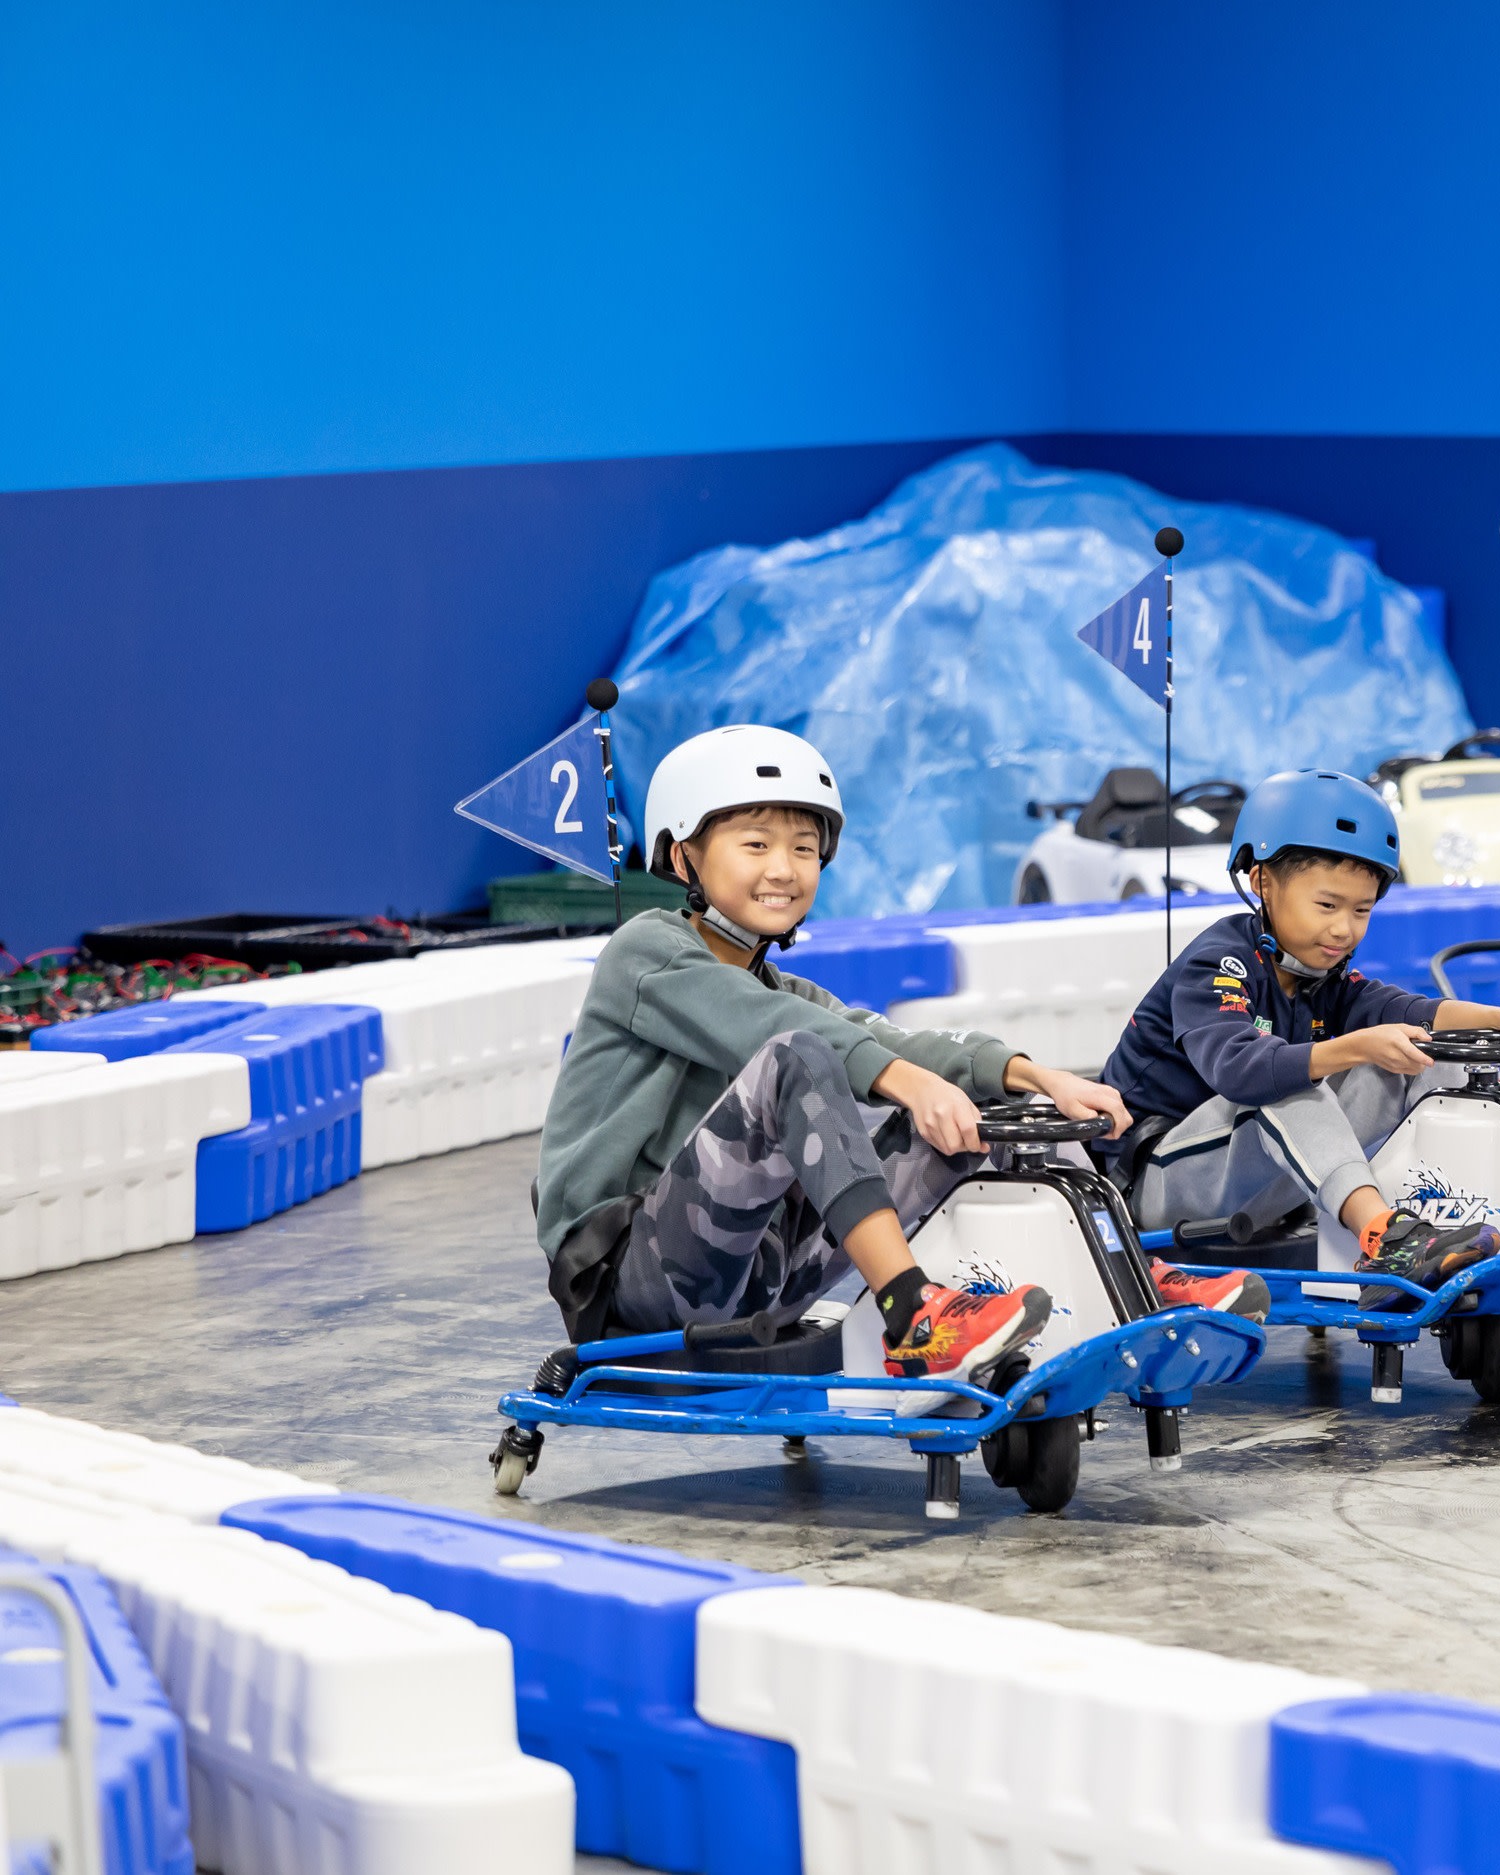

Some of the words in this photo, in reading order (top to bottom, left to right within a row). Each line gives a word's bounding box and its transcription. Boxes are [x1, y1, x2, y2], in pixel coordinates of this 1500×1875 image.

[1133, 598, 1153, 665] 4
[551, 760, 583, 834] 2
[1095, 1218, 1116, 1245] 2
